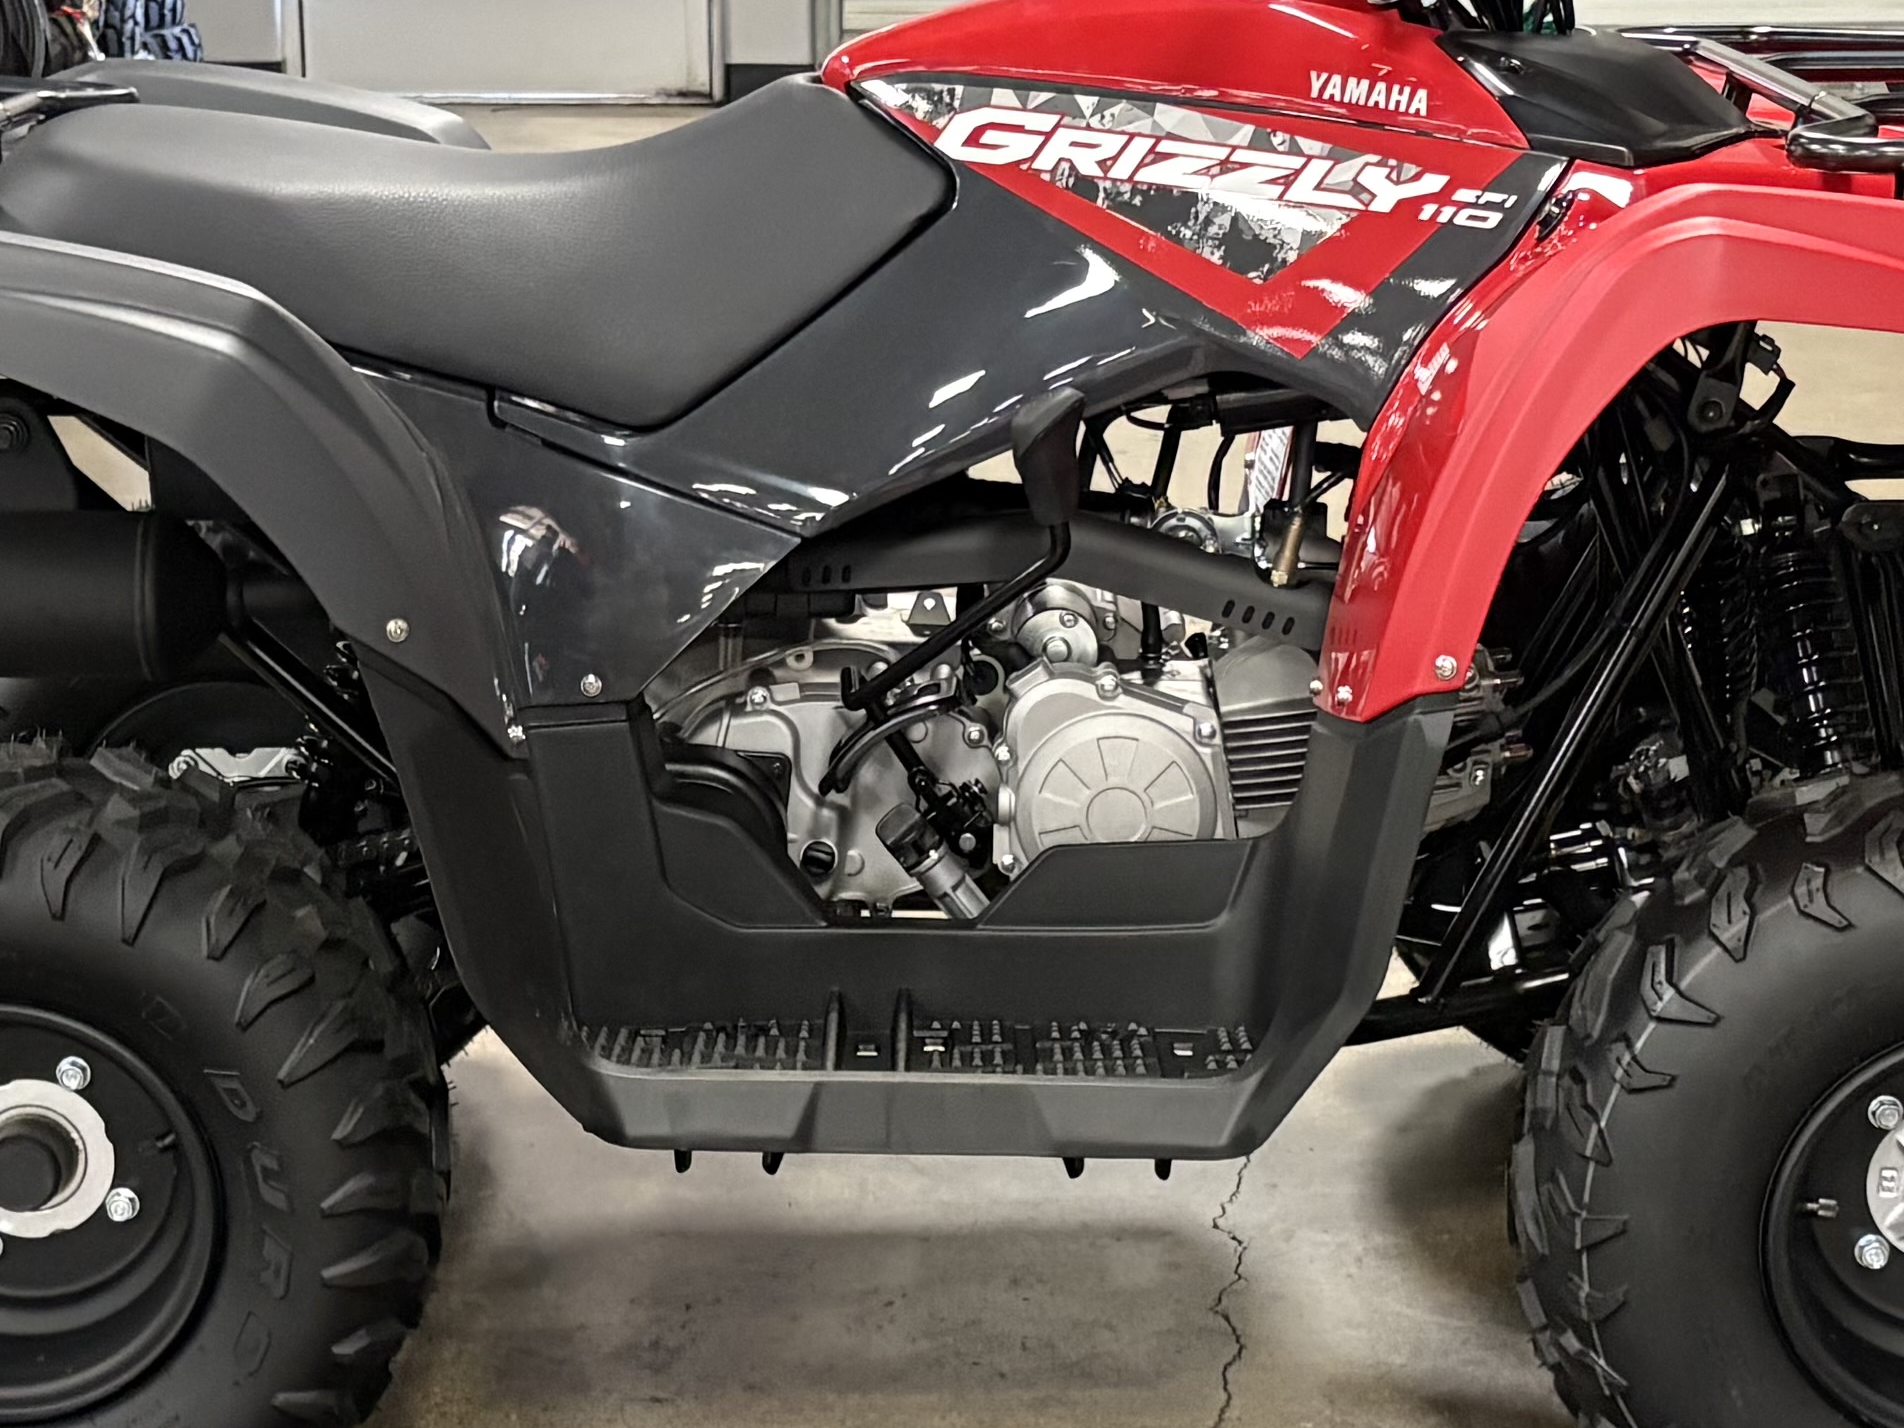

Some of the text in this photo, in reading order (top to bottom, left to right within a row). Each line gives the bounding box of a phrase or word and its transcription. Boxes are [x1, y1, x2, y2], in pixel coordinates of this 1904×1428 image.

[1309, 70, 1428, 117] YAMAHA
[933, 106, 1451, 213] GRIZZLY
[1418, 203, 1504, 229] 110
